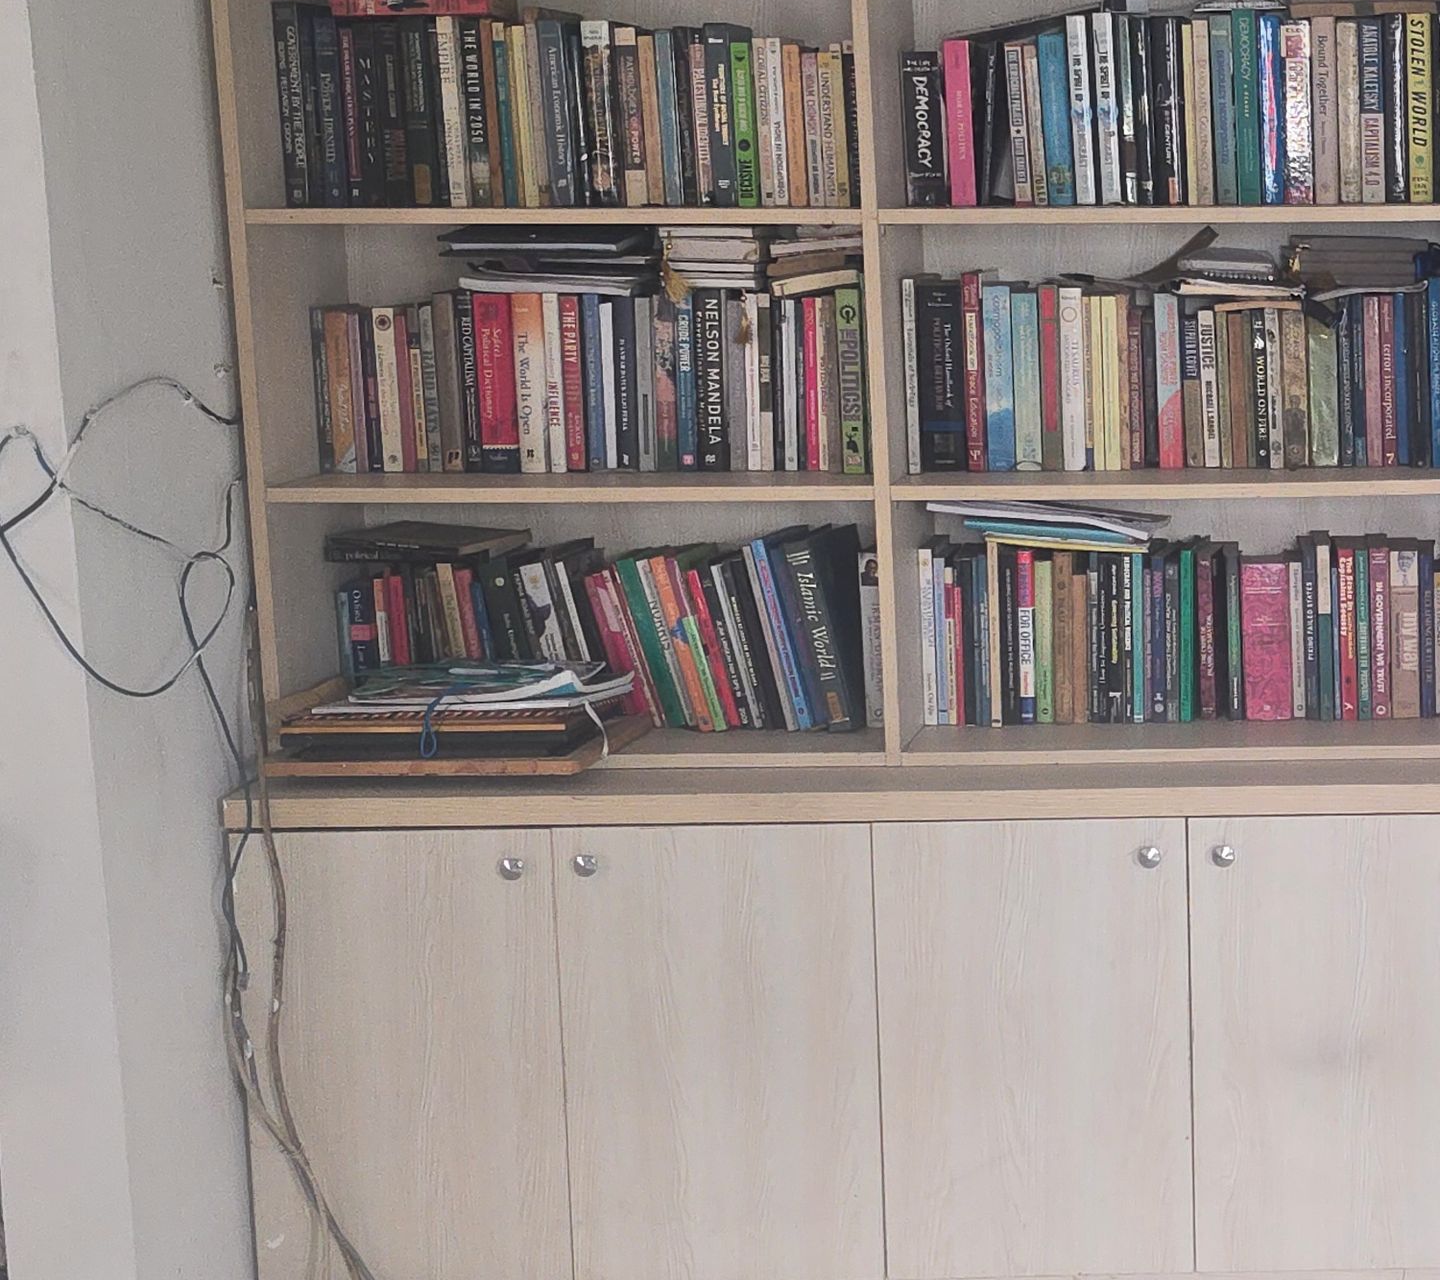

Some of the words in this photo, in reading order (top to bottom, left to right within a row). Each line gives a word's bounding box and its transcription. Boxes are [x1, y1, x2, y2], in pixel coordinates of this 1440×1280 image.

[464, 30, 476, 49] THE
[1239, 18, 1252, 80] DEMOCRACY
[1317, 35, 1328, 68] Bound
[1362, 25, 1379, 64] ANATOLE
[1410, 19, 1425, 77] STOLEN
[287, 26, 299, 94] GOVERNMENT
[439, 32, 450, 84] EMPIRE
[466, 54, 479, 93] WORLD
[547, 46, 559, 88] American
[291, 96, 300, 110] BY
[469, 98, 480, 110] IN
[820, 71, 832, 138] UNDERSTAND
[1317, 70, 1329, 115] Together
[1364, 66, 1380, 111] KALETSKY
[292, 113, 302, 129] THE
[551, 90, 563, 132] Economic
[913, 76, 933, 169] DEMOCRACY
[1411, 91, 1427, 147] WORLD
[470, 116, 483, 143] 2050
[1164, 124, 1172, 165] CENTURY
[1364, 117, 1380, 169] CAPITALISM
[294, 131, 304, 168] PEOPLE
[555, 134, 566, 166] History
[630, 130, 640, 164] POWER
[738, 159, 754, 199] DECISIVE
[1364, 170, 1380, 186] 4.0
[461, 317, 472, 334] RED
[563, 311, 576, 329] THE
[678, 315, 690, 342] CRUDE
[704, 298, 720, 362] NELSON
[944, 323, 952, 337] The
[1184, 320, 1196, 350] STEPHEN
[481, 328, 492, 367] Political
[517, 332, 528, 354] The
[564, 332, 577, 363] PARTY
[679, 343, 691, 372] POWER
[944, 338, 952, 361] Oxford
[1200, 323, 1214, 370] JUSTICE
[1383, 344, 1394, 372] terror
[461, 335, 474, 387] CAPITALISM
[519, 356, 530, 391] World
[840, 340, 860, 415] POLITICS
[1186, 356, 1197, 378] COVEY
[1256, 356, 1266, 397] WORLD
[483, 370, 494, 421] Dictionary
[945, 363, 954, 398] Handbook
[969, 371, 978, 395] Peace
[521, 394, 531, 403] Is
[548, 381, 561, 427] INFLUENCE
[707, 368, 722, 445] MANDELA
[946, 400, 955, 408] of
[1257, 399, 1267, 416] ON
[1384, 375, 1396, 440] incorporated
[520, 405, 532, 435] Open
[970, 398, 980, 438] Education
[1258, 418, 1268, 441] FIRE
[1339, 557, 1347, 600] Capitalist
[1374, 582, 1384, 592] IN
[351, 590, 363, 623] Oxford
[796, 572, 822, 622] Islamic
[809, 625, 834, 668] World
[1019, 610, 1031, 628] FOR
[1339, 603, 1348, 636] Society
[1374, 594, 1384, 651] GOVERNMENT
[1402, 612, 1418, 643] my
[1020, 631, 1031, 665] OFFICE
[1376, 654, 1384, 668] WE
[1402, 645, 1418, 672] way
[1376, 670, 1384, 693] TRUST
